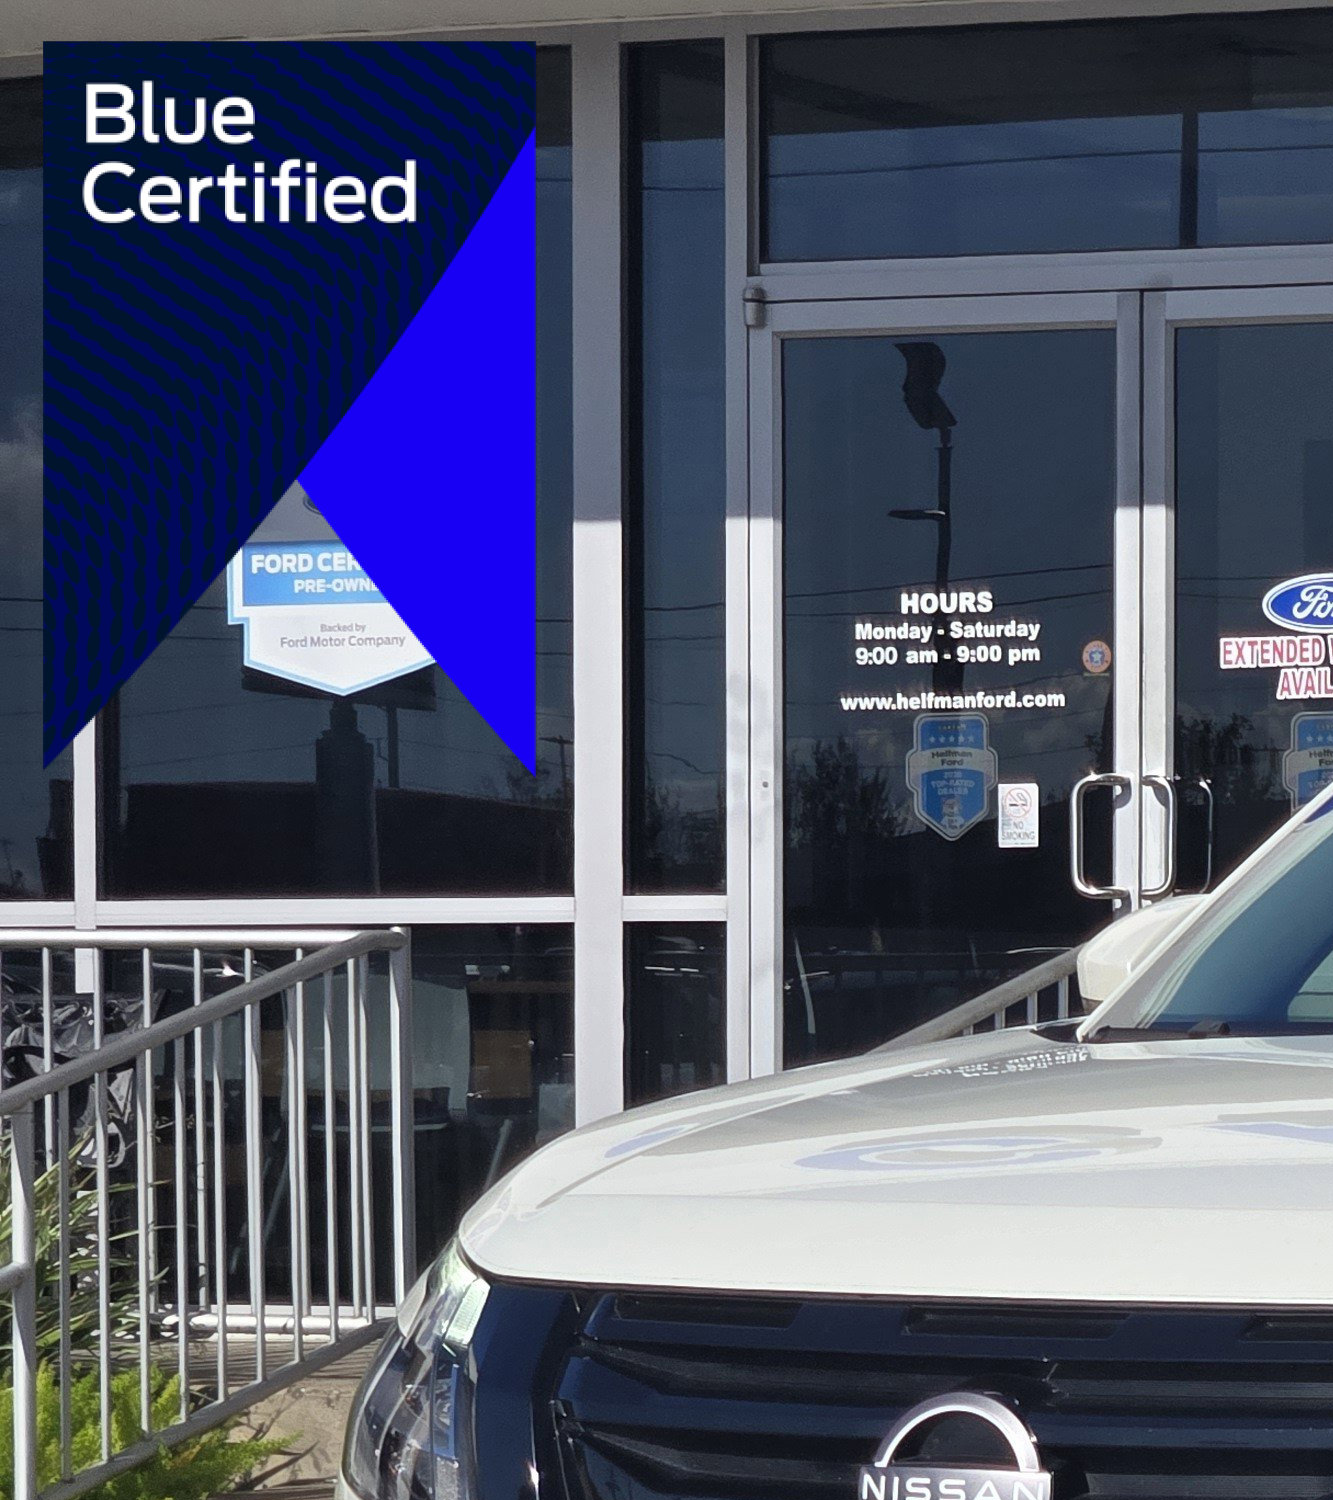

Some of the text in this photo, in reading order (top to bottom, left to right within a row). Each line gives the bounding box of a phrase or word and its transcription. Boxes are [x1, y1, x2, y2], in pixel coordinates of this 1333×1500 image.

[251, 553, 313, 574] FORD
[900, 591, 993, 614] HOURS
[319, 623, 366, 634] Backed by
[855, 622, 932, 643] Monday
[950, 620, 1040, 641] Saturday
[280, 635, 406, 648] Ford Motor Company
[1221, 635, 1324, 667] EXTENDED
[855, 647, 898, 665] 9:00
[905, 650, 938, 664] am
[956, 645, 1002, 663] 9:00
[1008, 648, 1041, 666] pm
[840, 691, 1066, 710] www.helfmanford.com
[1012, 821, 1024, 829] NO
[1001, 831, 1035, 840] SMOKING
